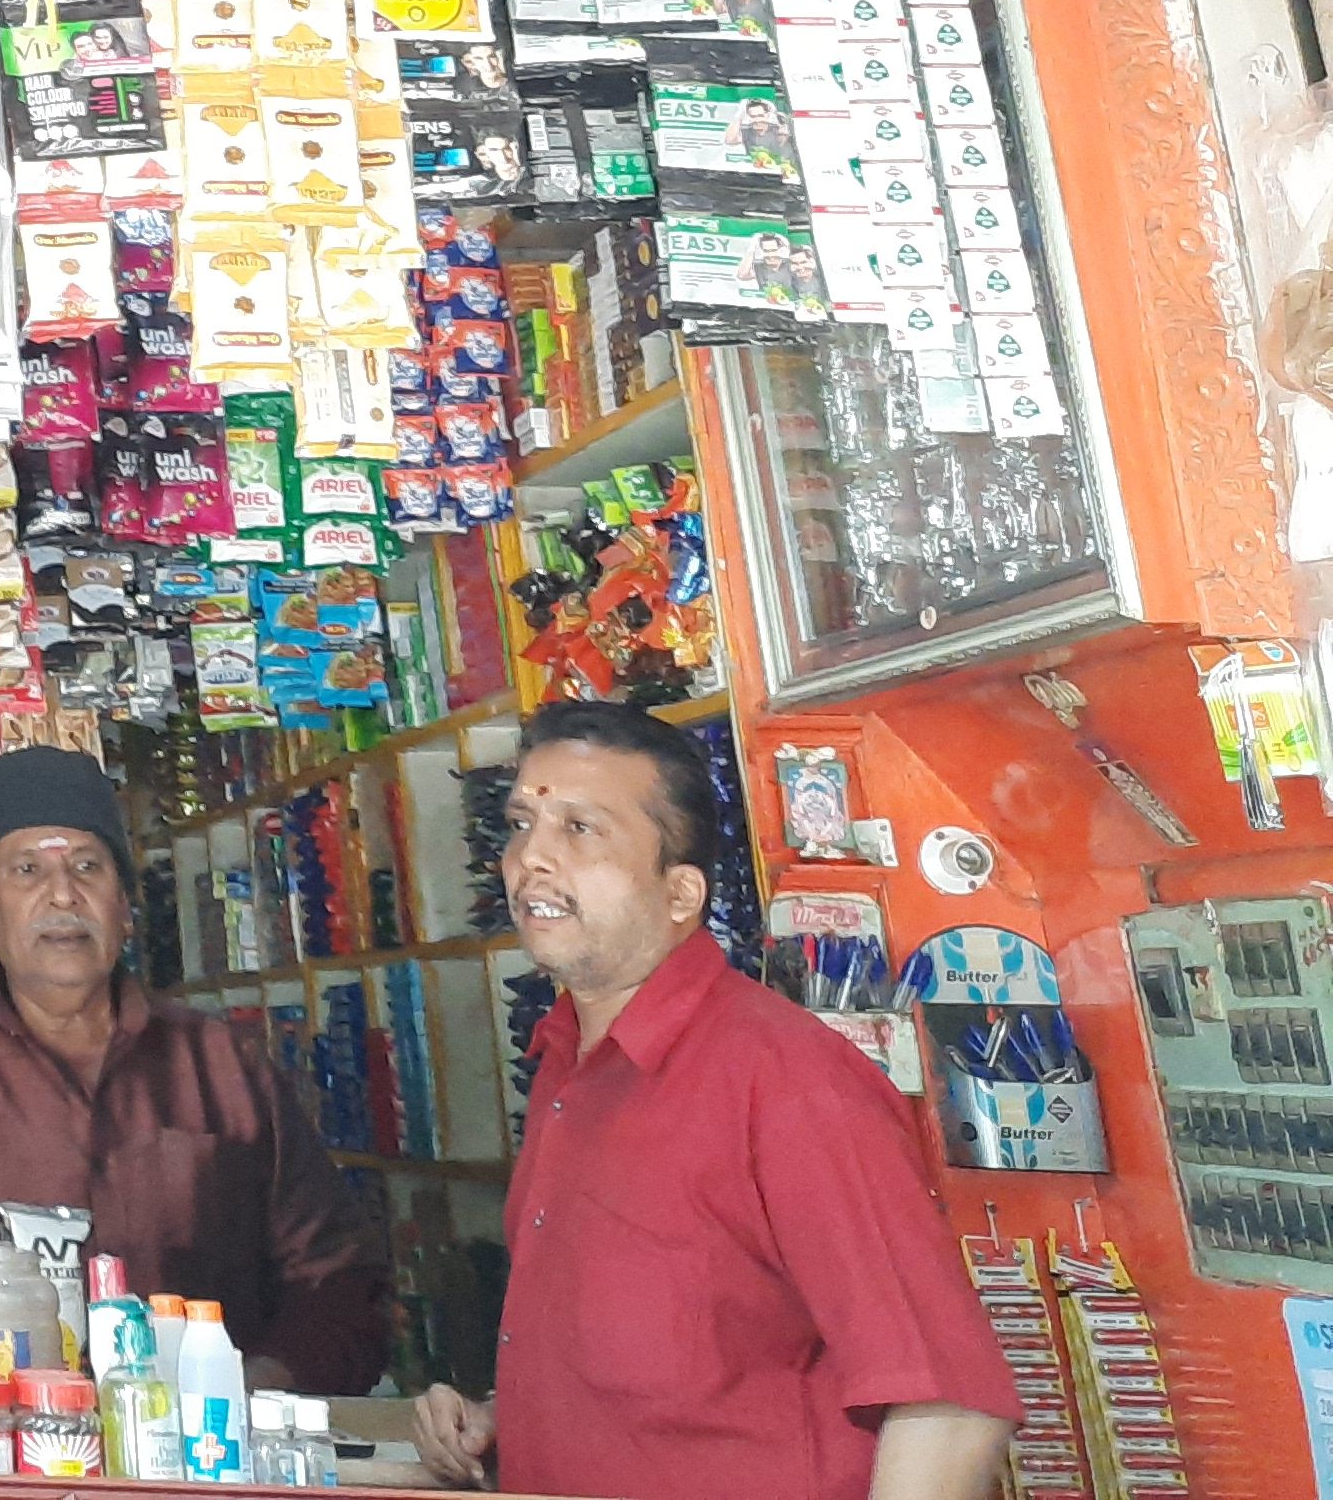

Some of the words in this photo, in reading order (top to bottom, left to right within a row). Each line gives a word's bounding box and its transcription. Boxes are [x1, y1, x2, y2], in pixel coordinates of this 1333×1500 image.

[14, 37, 61, 61] VIP
[24, 75, 54, 91] HAIR
[26, 87, 72, 106] COLOUR
[28, 101, 88, 122] SHAMPOO
[659, 102, 719, 119] EASY
[410, 119, 452, 136] ENS
[671, 234, 731, 253] EASY
[140, 324, 176, 345] uni
[155, 447, 192, 468] uni
[155, 462, 219, 484] wash
[309, 477, 368, 494] ARIEL
[231, 491, 276, 507] RIEL
[311, 528, 373, 546] ARIEL
[946, 969, 1000, 985] Butter
[999, 1125, 1055, 1142] Butter
